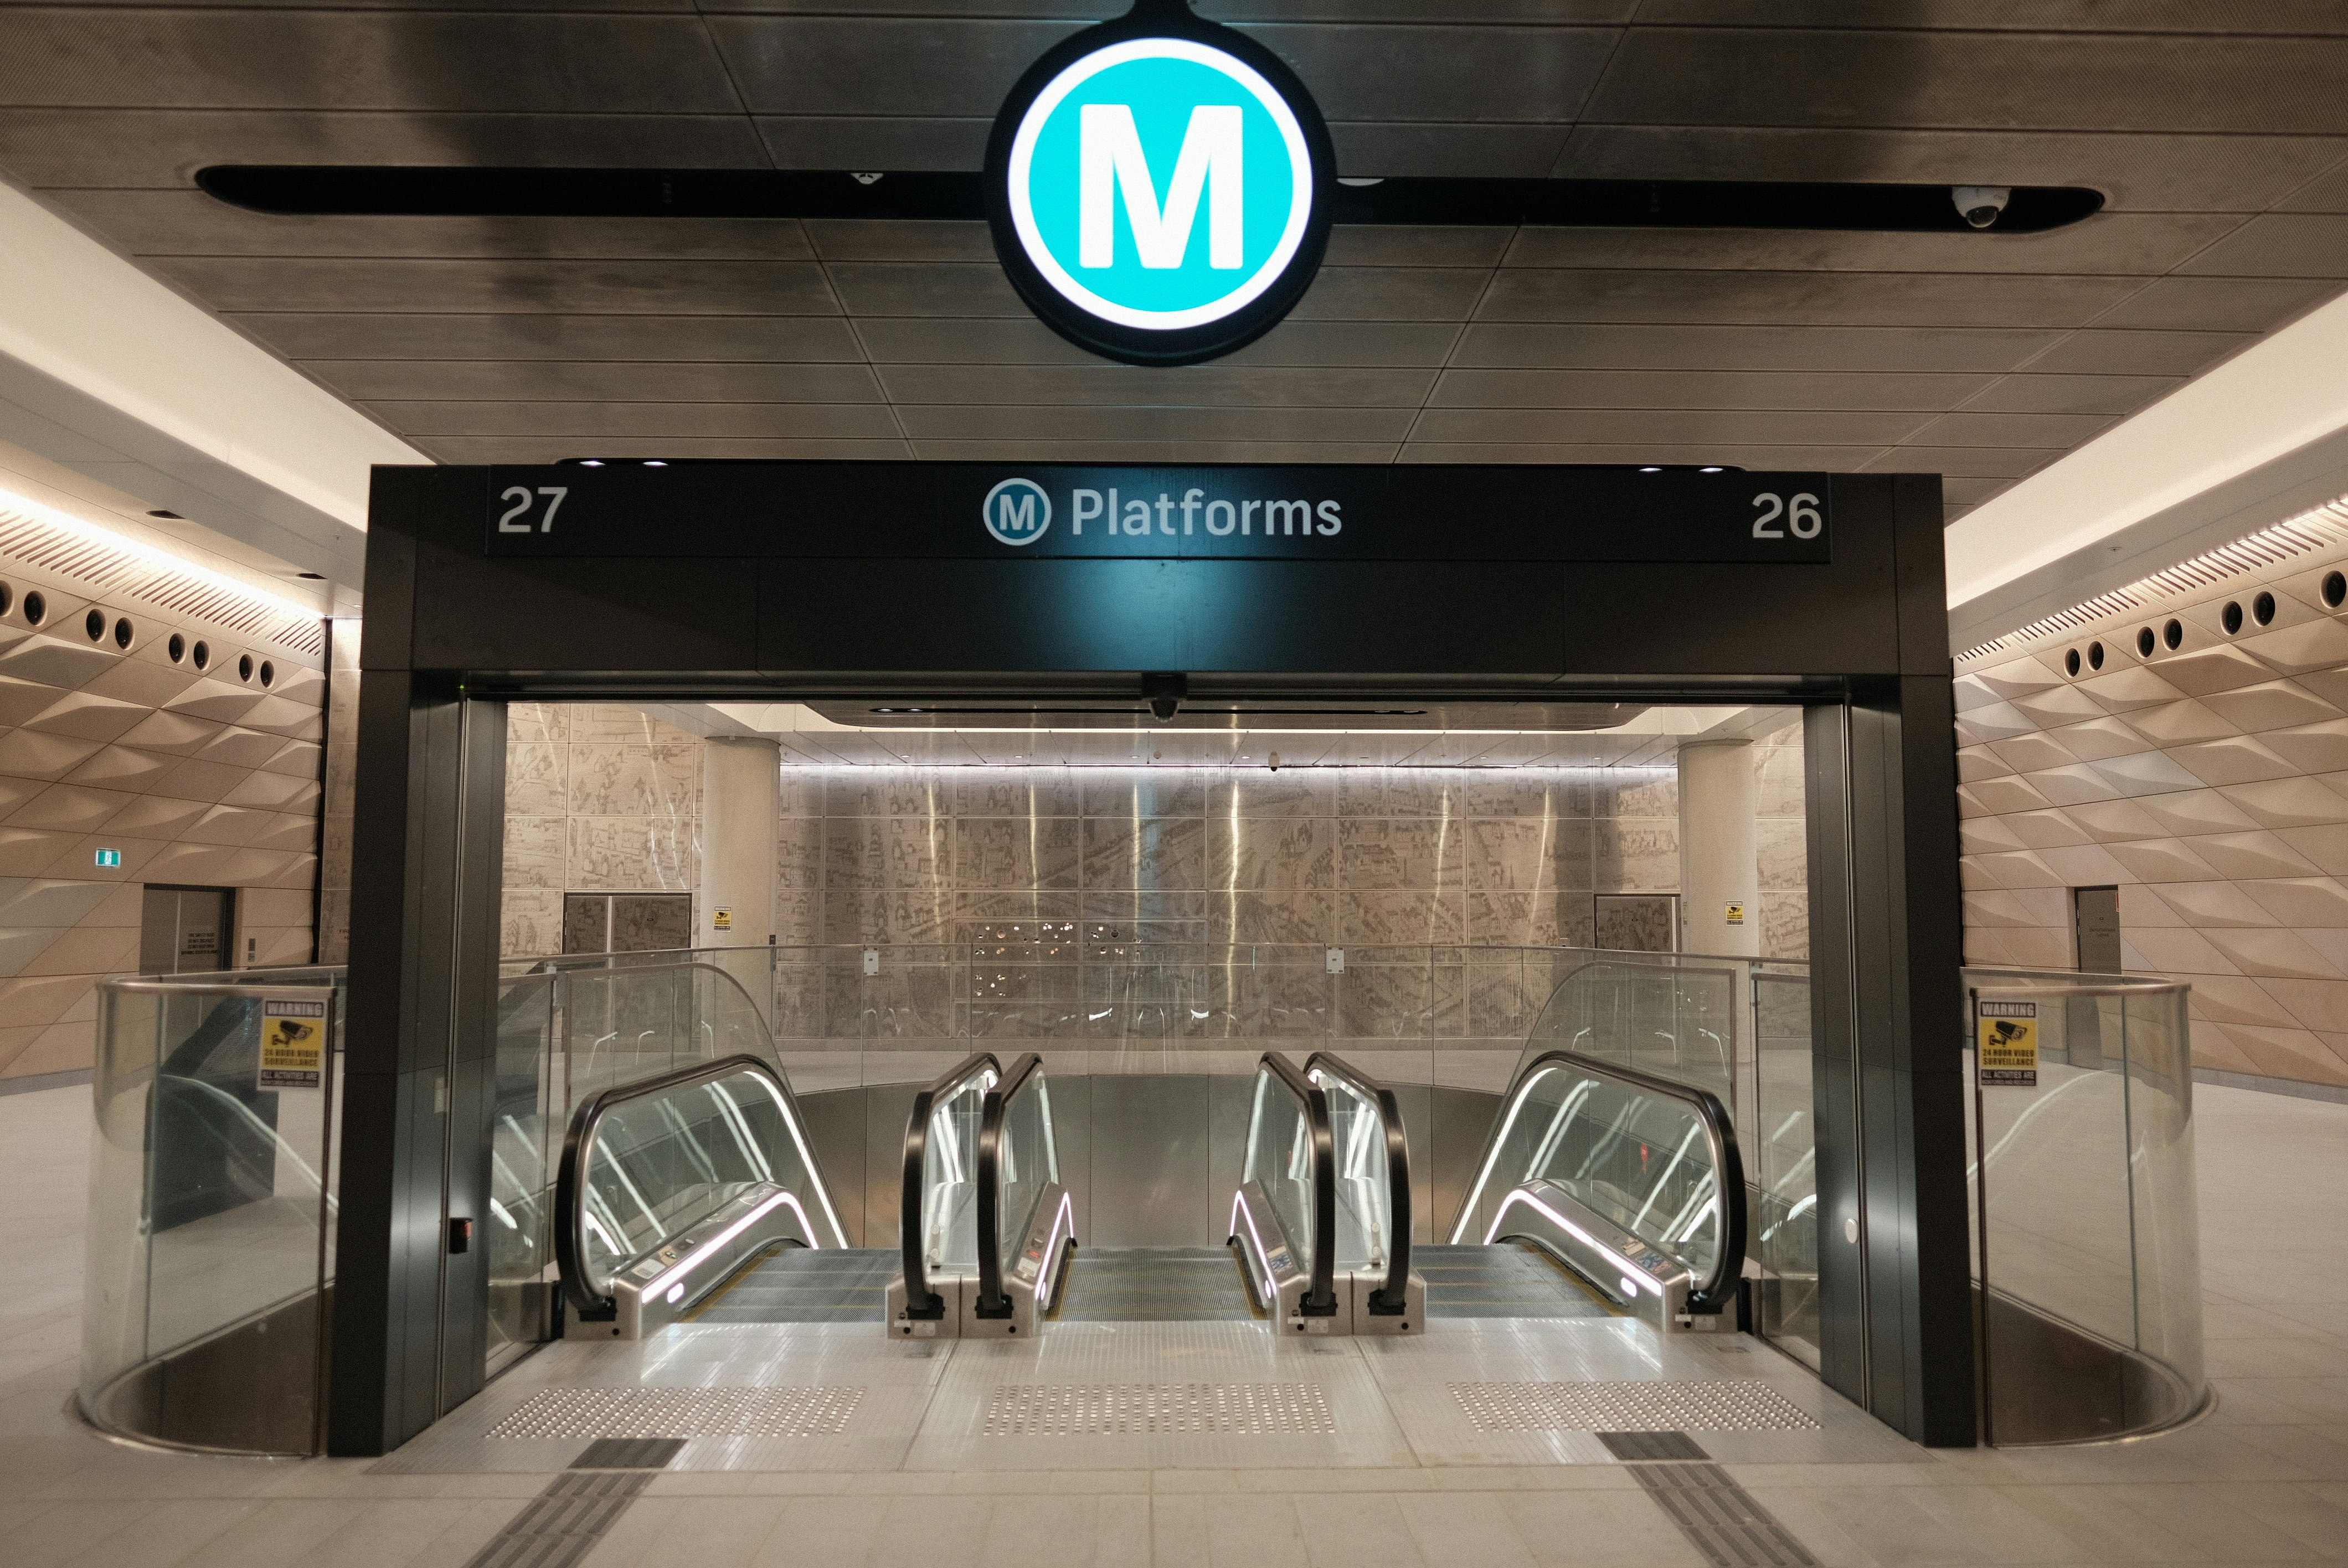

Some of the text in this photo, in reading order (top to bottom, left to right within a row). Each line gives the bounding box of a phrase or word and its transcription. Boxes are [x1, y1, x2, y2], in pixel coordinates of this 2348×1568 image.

[1079, 104, 1243, 270] M
[498, 486, 568, 533] 27
[1000, 488, 1342, 536] M Platforms
[1752, 492, 1822, 539] 26
[267, 1003, 322, 1017] WARNING
[1981, 1003, 2034, 1016] WARNING
[265, 1048, 273, 1056] 24
[1983, 1058, 2034, 1066] SURVEILLANCE
